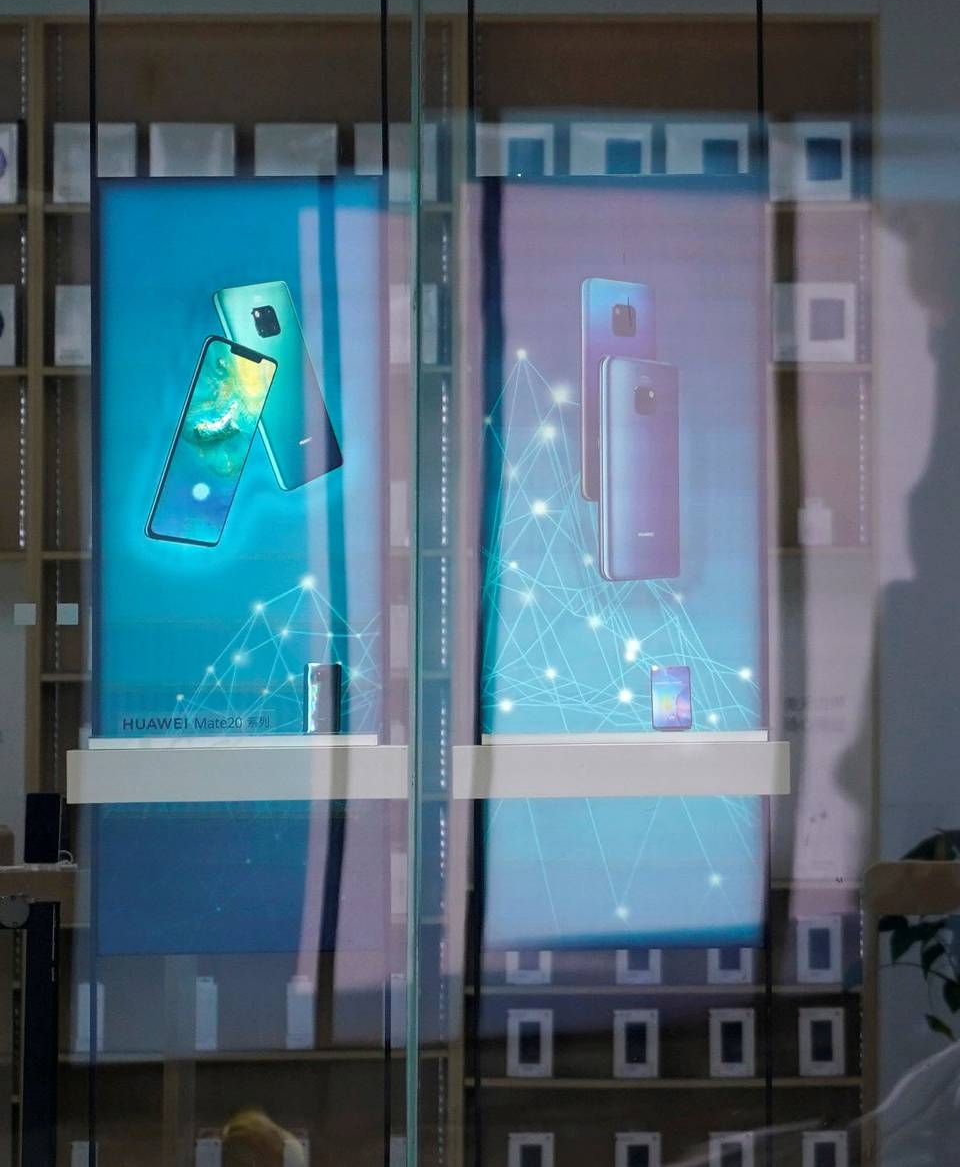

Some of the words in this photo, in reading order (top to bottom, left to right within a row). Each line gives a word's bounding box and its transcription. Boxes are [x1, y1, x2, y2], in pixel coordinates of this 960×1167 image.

[122, 717, 188, 731] HUAWEI
[193, 716, 243, 730] Mate20
[247, 714, 271, 730] 系列
